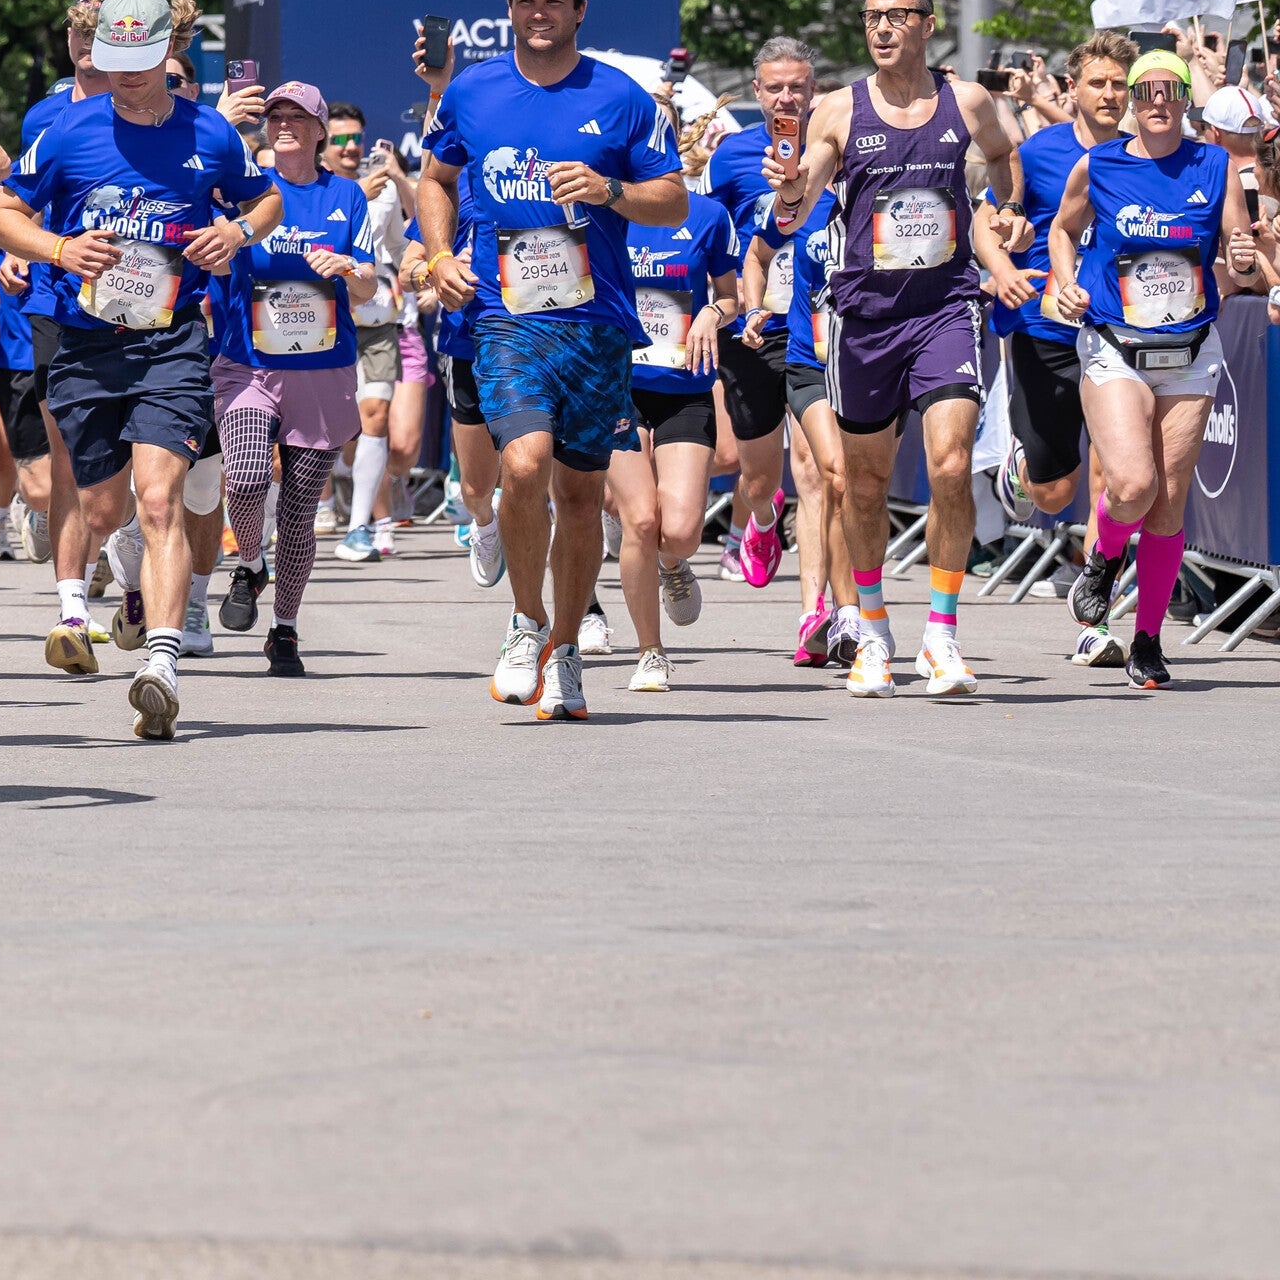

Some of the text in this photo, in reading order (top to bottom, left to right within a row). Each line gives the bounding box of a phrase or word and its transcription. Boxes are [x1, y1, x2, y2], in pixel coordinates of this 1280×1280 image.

[110, 31, 148, 42] Red Bull
[866, 161, 955, 175] Captain Team Audi
[521, 171, 546, 182] LIFE
[499, 179, 555, 202] WORL
[120, 200, 165, 213] WINGS
[99, 216, 164, 242] WORLD
[895, 223, 939, 237] 32202
[1128, 223, 1193, 238] WORLD RUN
[272, 240, 311, 254] WORLD
[521, 262, 568, 279] 29544
[632, 264, 689, 278] ORLD RUN
[106, 274, 155, 298] 30289
[537, 284, 558, 293] Philip
[1143, 280, 1185, 297] 32802
[575, 289, 583, 300] 3
[117, 298, 132, 309] Erik
[148, 318, 156, 327] 4
[273, 311, 316, 324] 28398
[643, 322, 669, 336] 346
